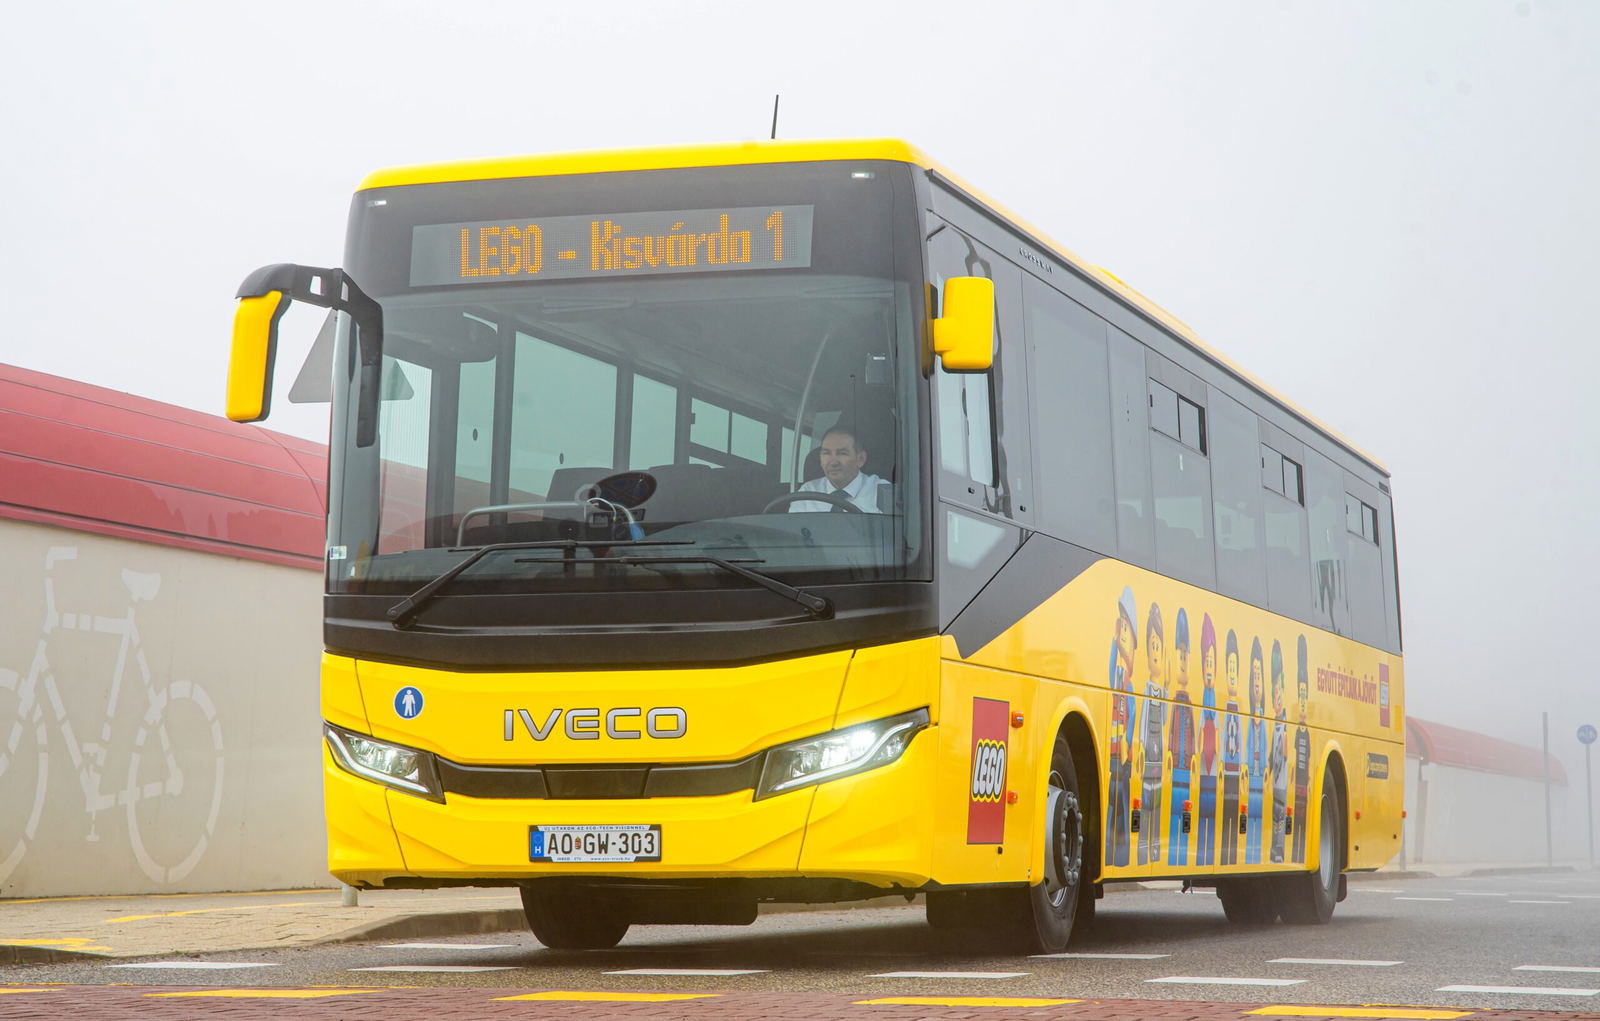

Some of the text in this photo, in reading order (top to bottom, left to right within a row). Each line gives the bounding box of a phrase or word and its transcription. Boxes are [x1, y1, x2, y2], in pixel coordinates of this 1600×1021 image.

[461, 210, 782, 278] LEGO - Kisvárda 1
[504, 707, 687, 742] IVECO
[972, 743, 1006, 797] LEGO
[548, 832, 655, 855] AO GW-303
